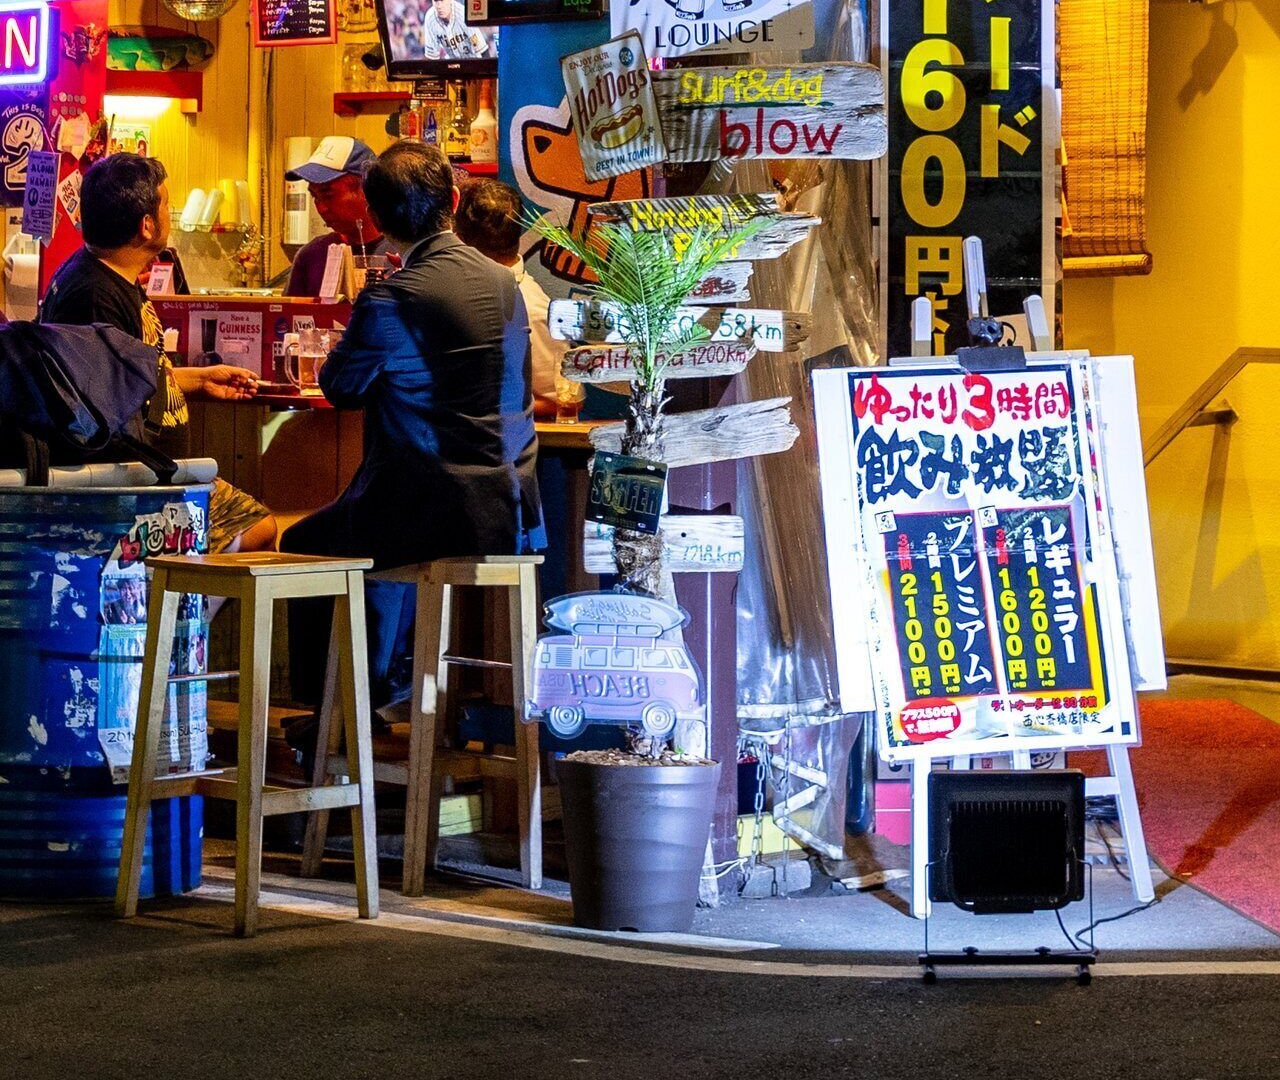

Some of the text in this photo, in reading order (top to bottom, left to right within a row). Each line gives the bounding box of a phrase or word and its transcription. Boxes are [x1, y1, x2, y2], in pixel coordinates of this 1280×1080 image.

[655, 19, 775, 49] LOUNGE
[595, 158, 615, 172] BEST
[616, 154, 626, 166] IN
[719, 107, 844, 157] blow
[219, 321, 261, 336] GUINNESS
[853, 374, 1071, 432] ゆったり3時間
[856, 426, 1075, 504] 飲み放題
[899, 572, 933, 689] 2100円
[930, 571, 961, 686] 1500円
[942, 515, 993, 686] プレミアム
[998, 567, 1028, 682] 1600円
[1026, 566, 1057, 680] 1200円
[1041, 516, 1079, 665] レギュラー
